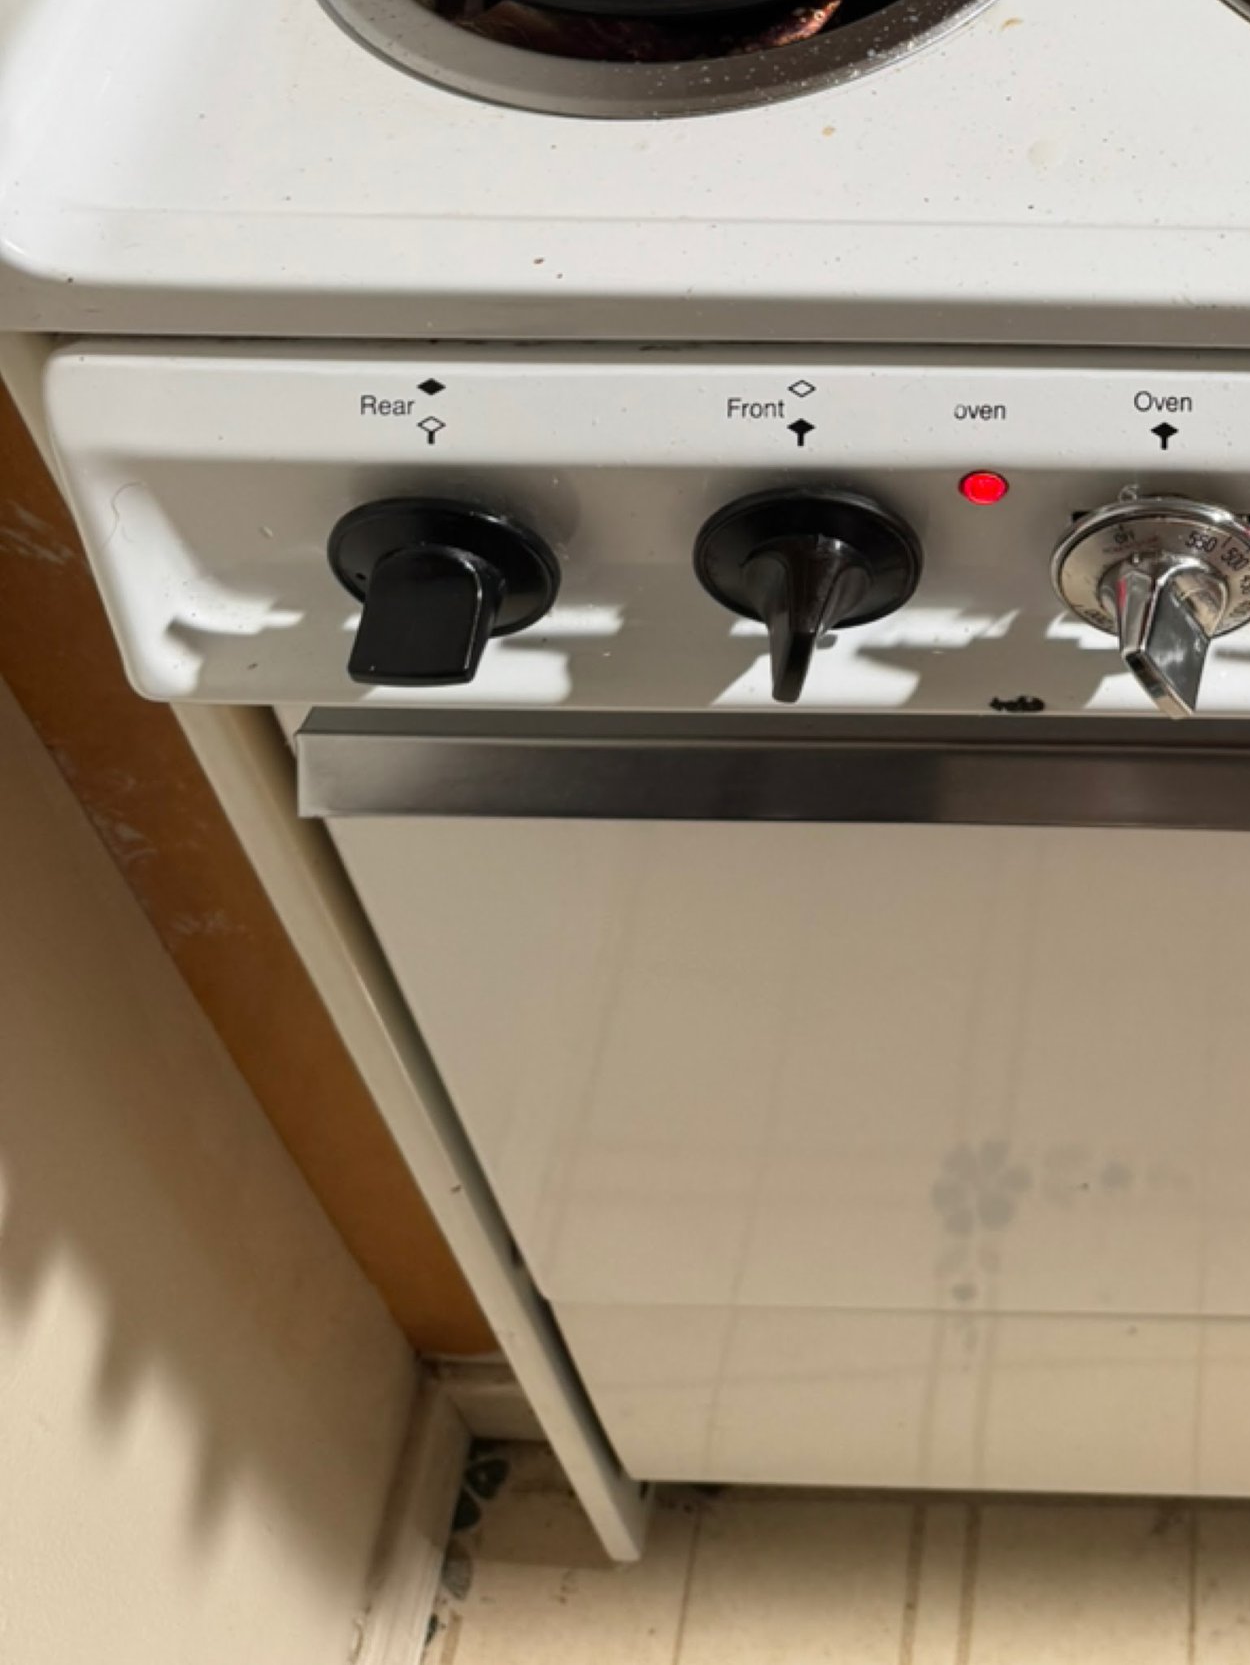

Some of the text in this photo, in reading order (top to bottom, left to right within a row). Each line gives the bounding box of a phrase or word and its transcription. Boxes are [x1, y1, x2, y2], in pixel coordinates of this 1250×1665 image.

[360, 394, 415, 416] Rear
[727, 397, 785, 419] Front
[953, 403, 1006, 421] oven
[1133, 390, 1193, 413] Oven
